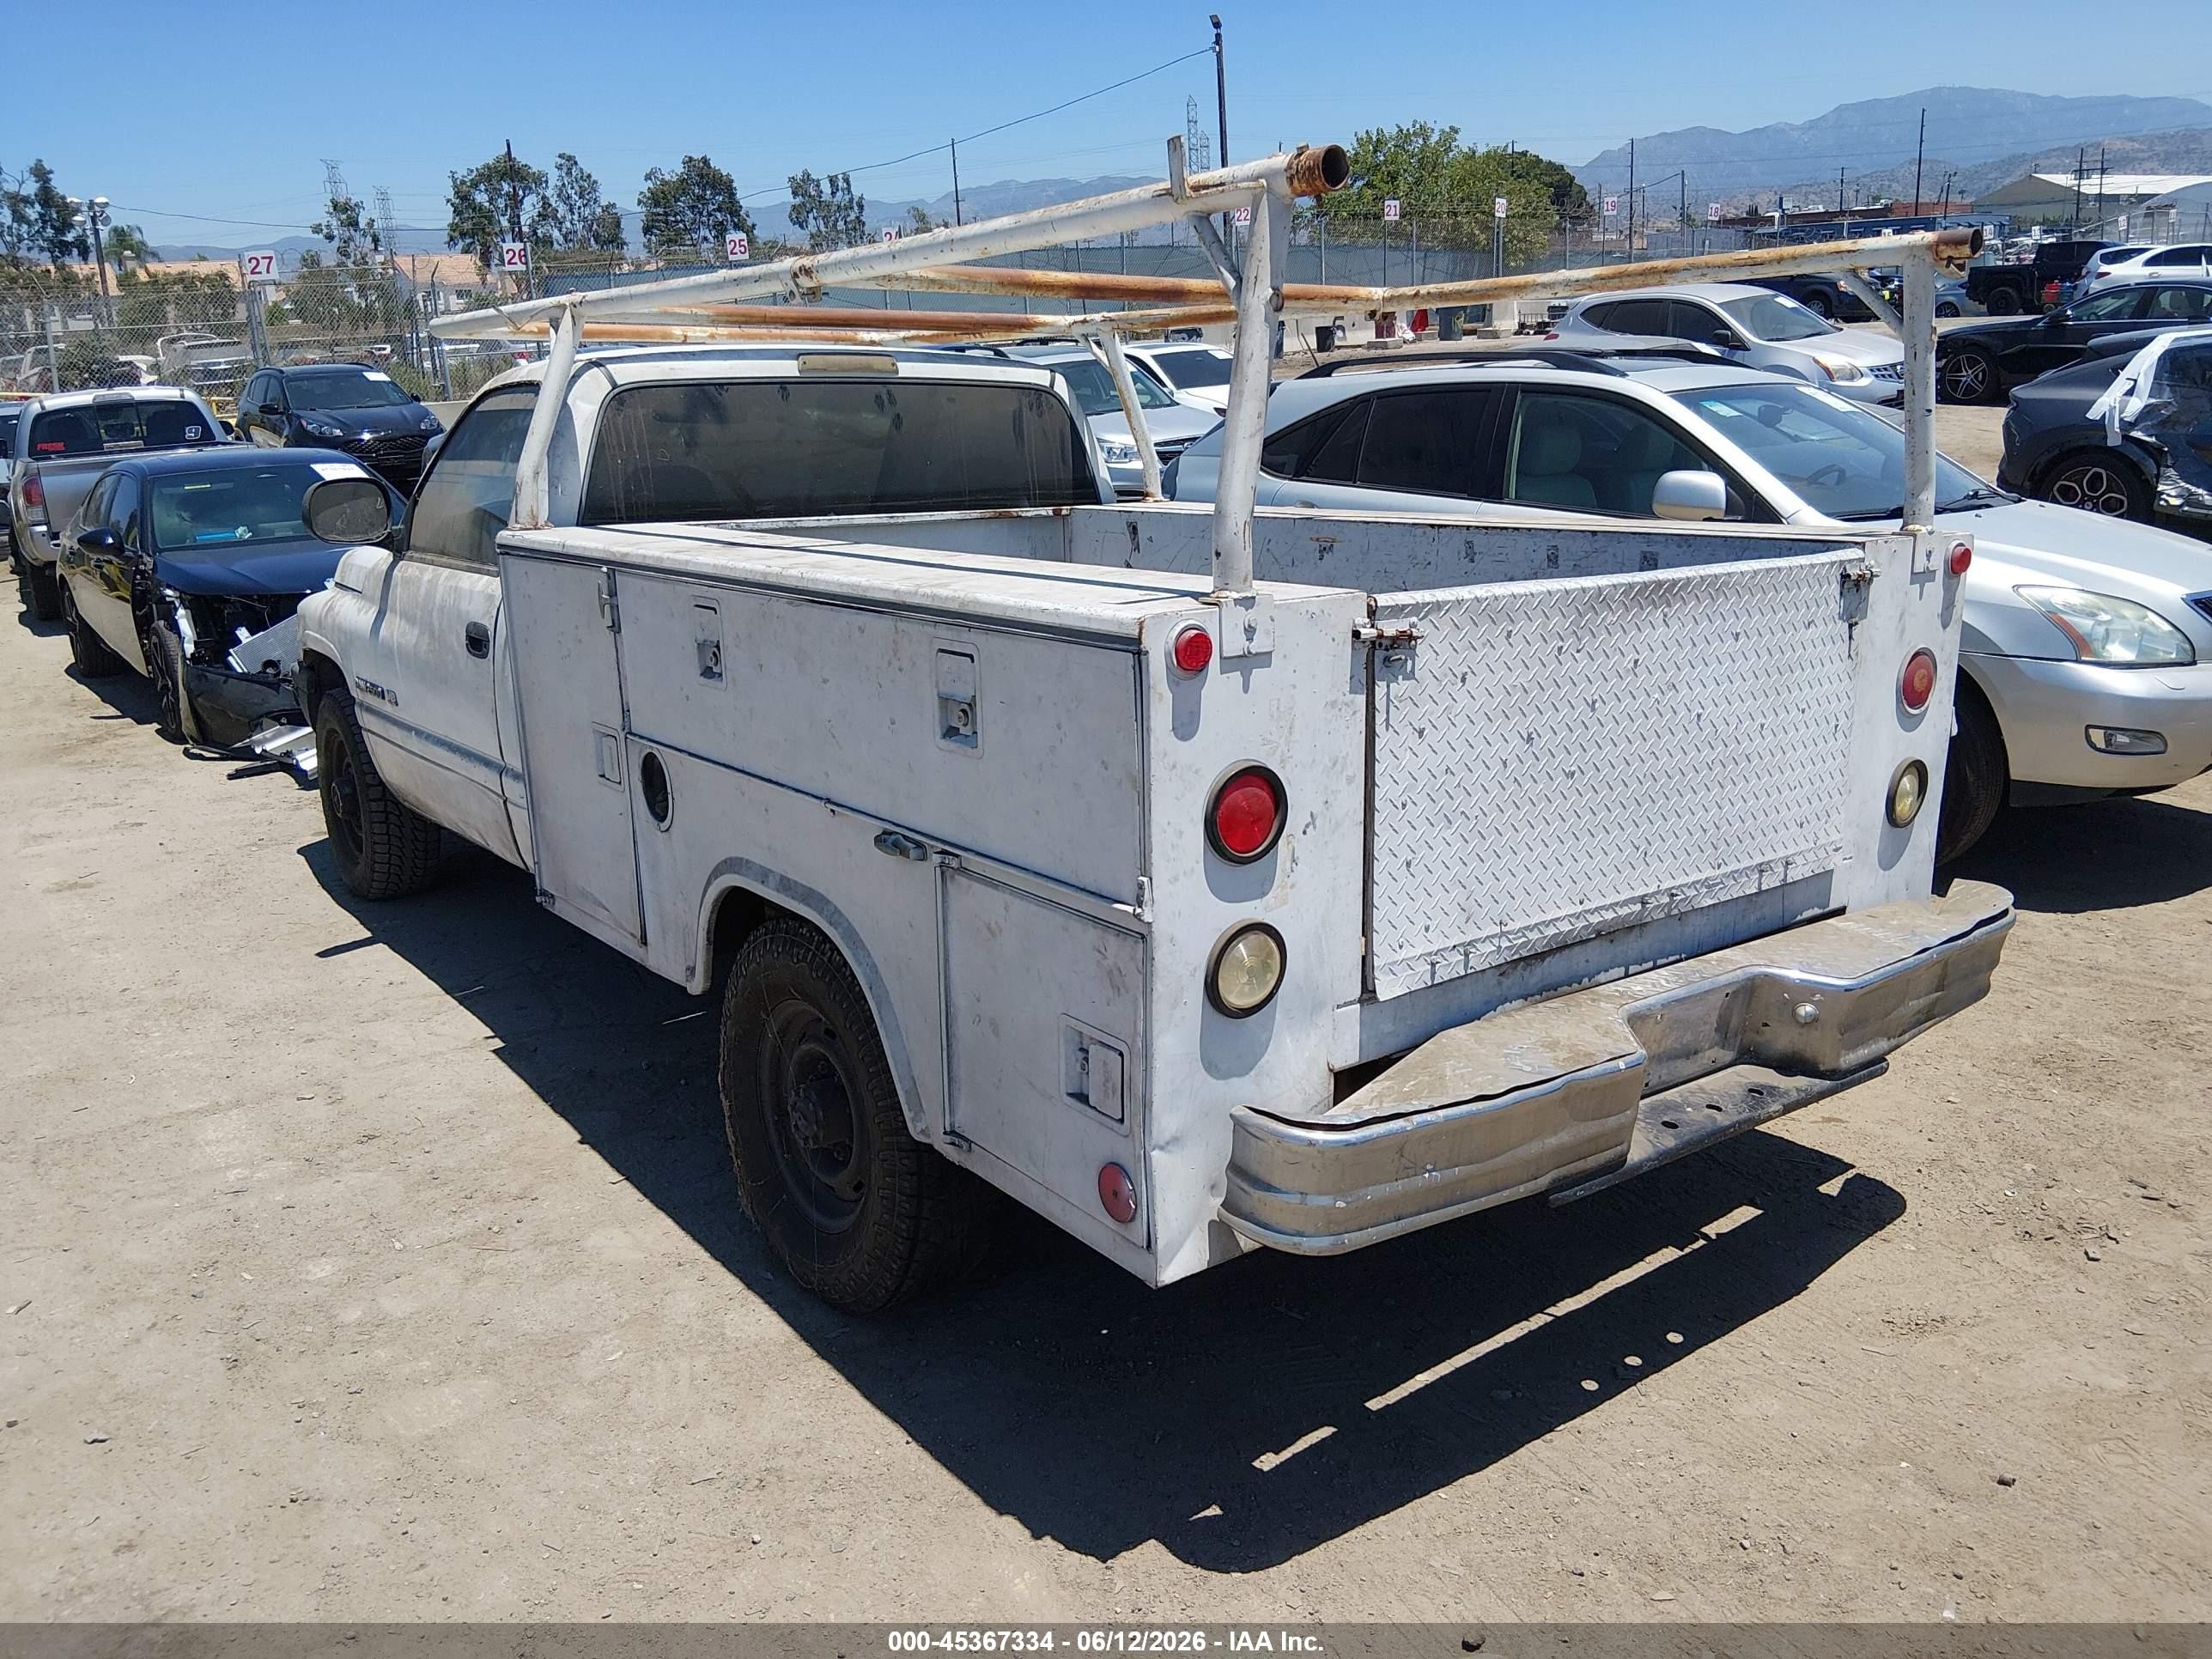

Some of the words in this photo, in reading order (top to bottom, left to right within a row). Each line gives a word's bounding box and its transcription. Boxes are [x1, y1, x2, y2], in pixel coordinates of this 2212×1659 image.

[1386, 204, 1398, 216] 21
[1497, 202, 1505, 214] 20
[1605, 201, 1616, 211] 19
[1709, 207, 1719, 217] 18
[1237, 209, 1250, 222] 22
[729, 239, 747, 255] 25
[506, 248, 528, 265] 26
[248, 256, 274, 275] 27
[185, 425, 202, 440] 9
